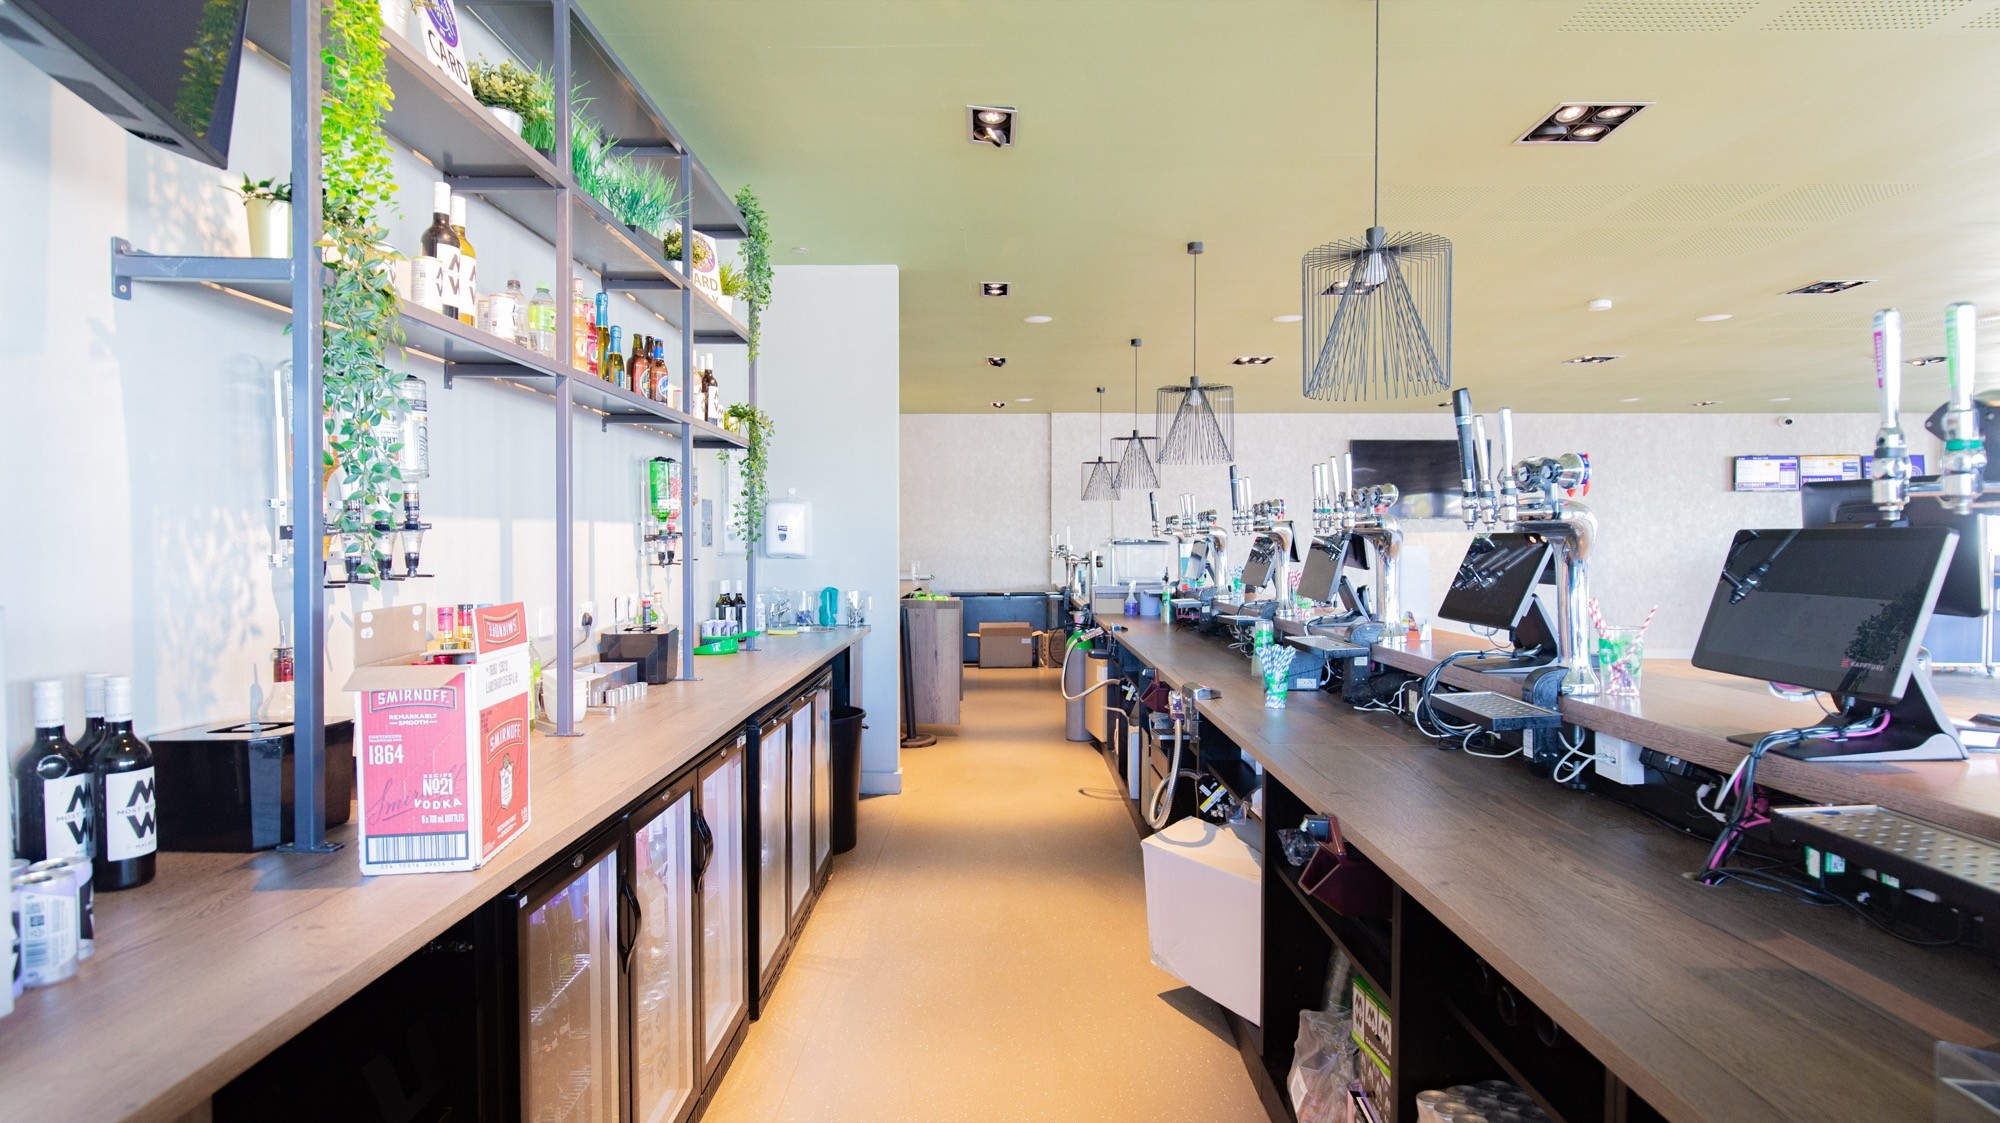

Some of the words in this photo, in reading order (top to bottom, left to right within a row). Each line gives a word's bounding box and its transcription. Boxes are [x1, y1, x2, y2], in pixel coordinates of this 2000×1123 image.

[428, 29, 468, 86] CARD
[693, 272, 719, 292] ARD
[388, 712, 438, 721] REMARKABLY
[398, 719, 429, 727] SMOOTH
[490, 723, 521, 753] SMIRNOFF
[368, 744, 404, 765] 1864
[413, 797, 462, 810] VODKA
